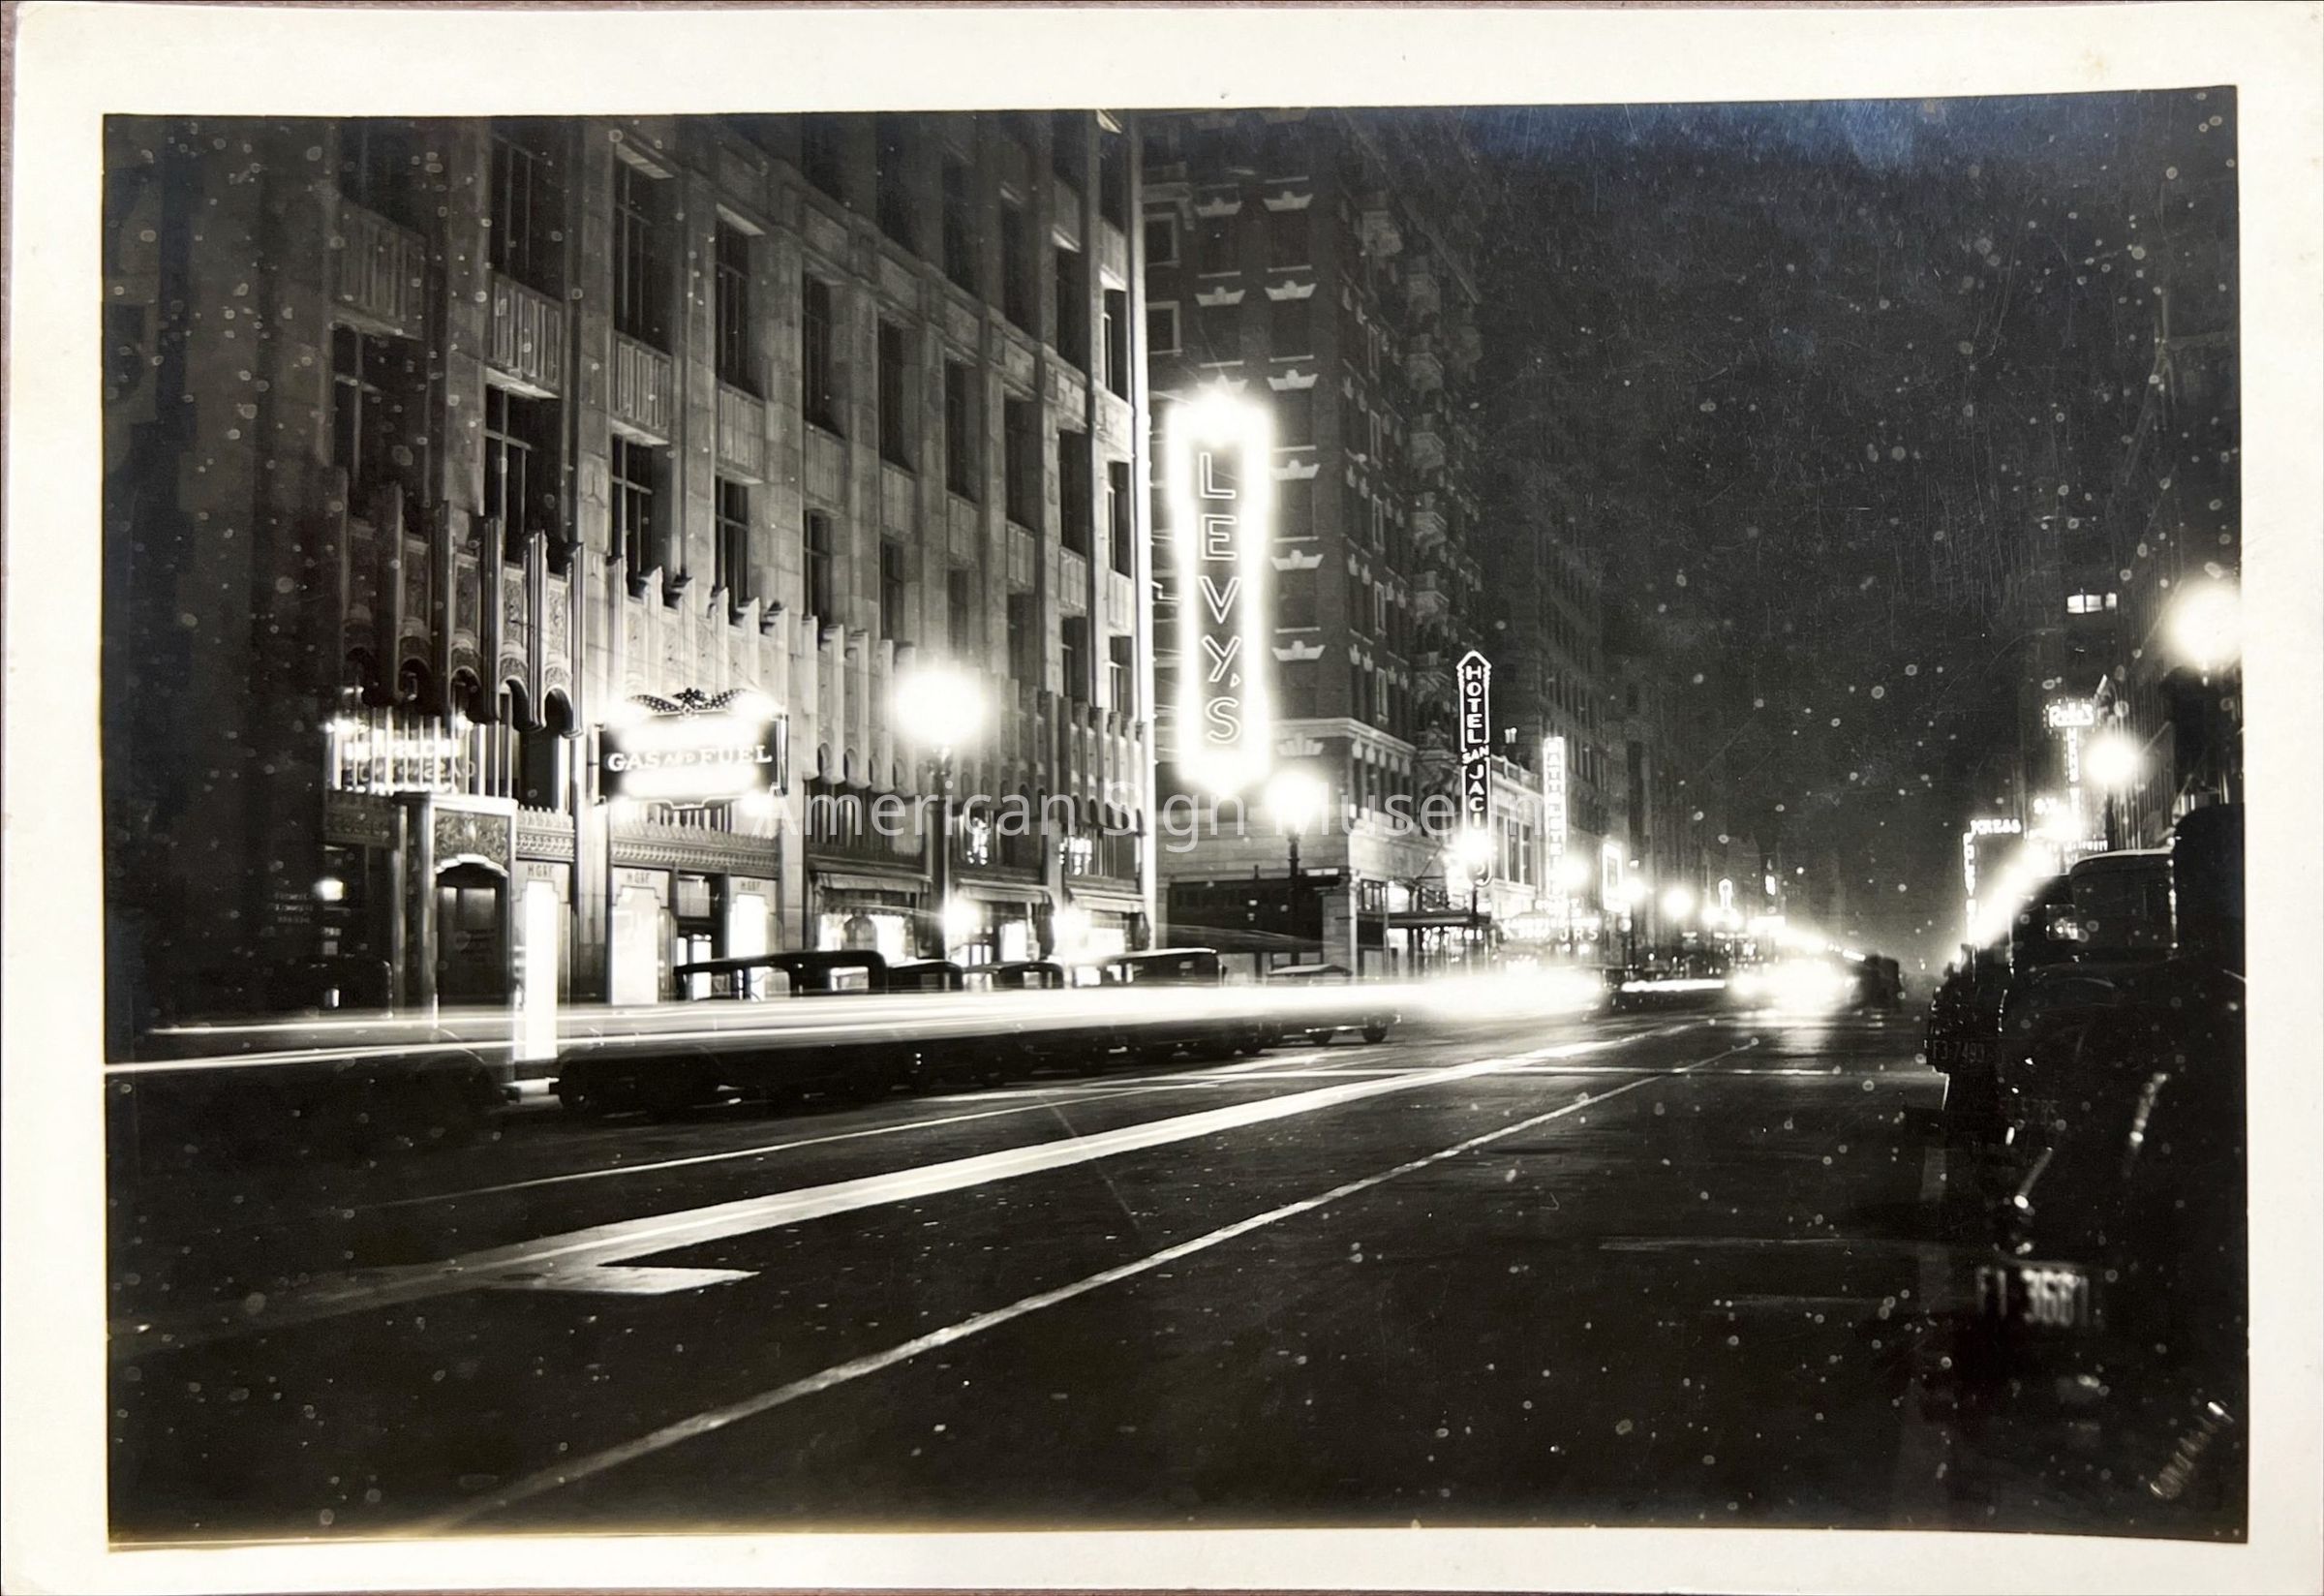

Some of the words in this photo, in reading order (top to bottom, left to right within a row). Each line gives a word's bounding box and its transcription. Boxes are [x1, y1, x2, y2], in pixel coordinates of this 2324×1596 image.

[1198, 451, 1242, 745] LEVY'S
[1466, 664, 1483, 744] HOTEL
[608, 750, 660, 771] GAS
[700, 745, 773, 765] FUEL
[1462, 745, 1490, 765] SAN
